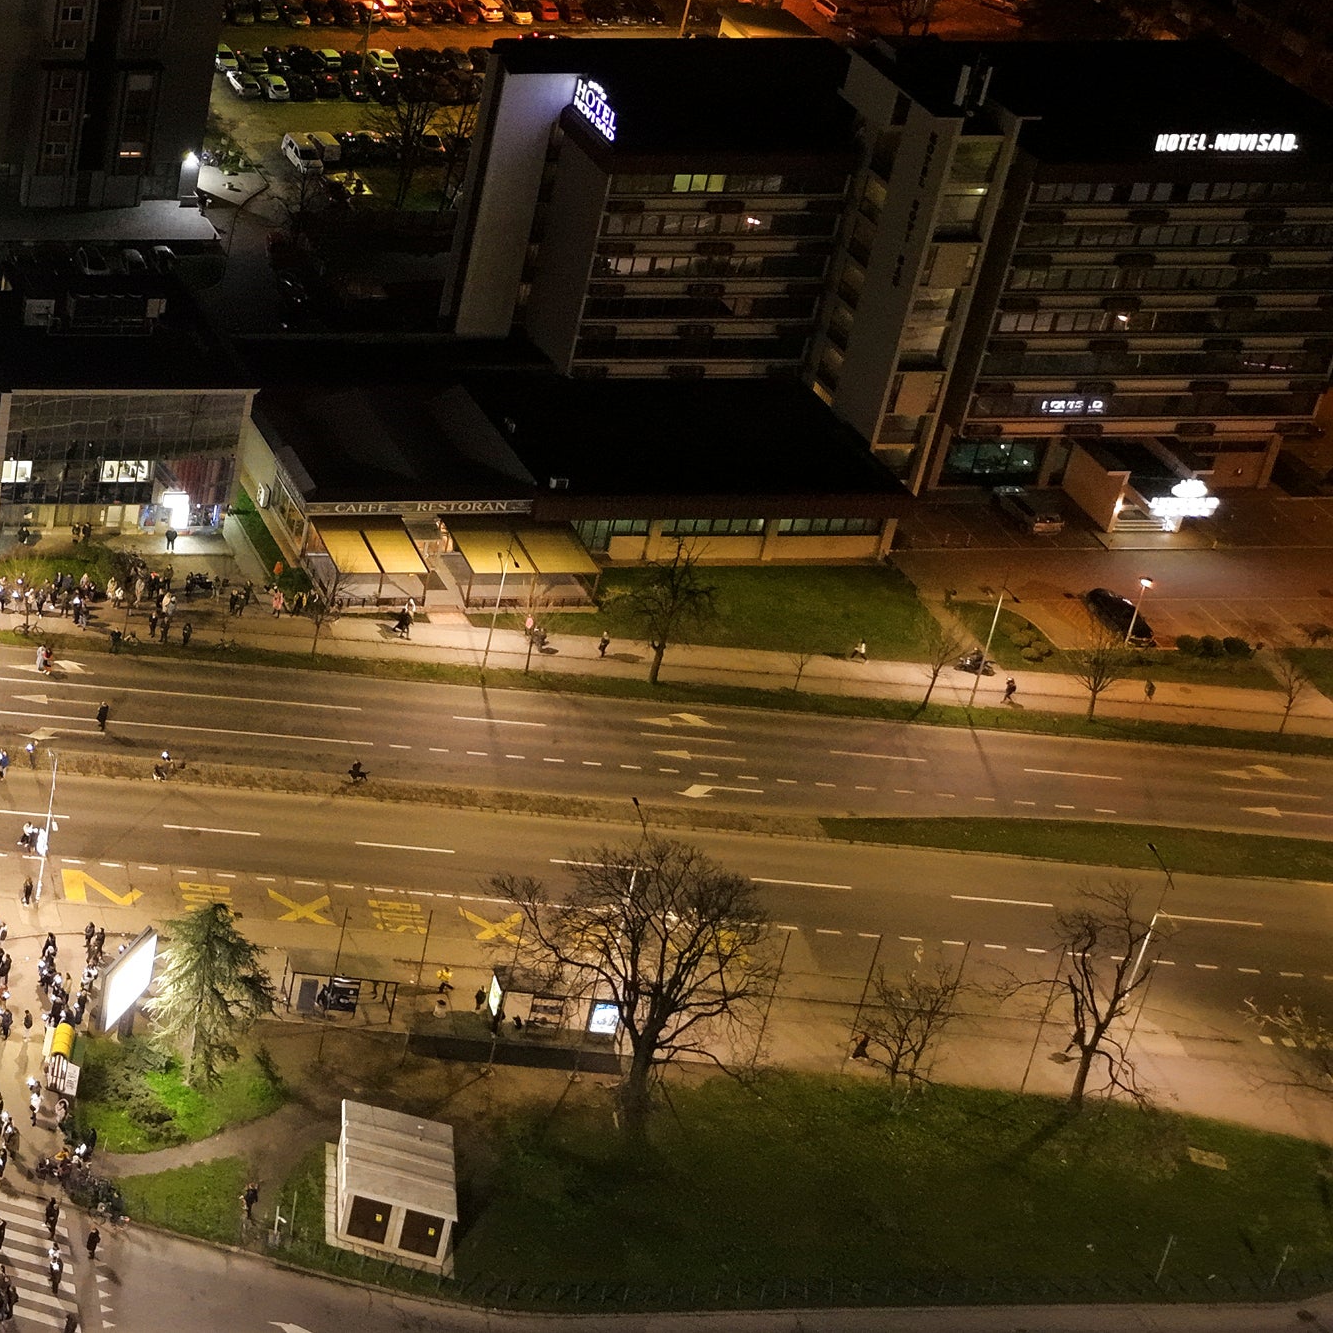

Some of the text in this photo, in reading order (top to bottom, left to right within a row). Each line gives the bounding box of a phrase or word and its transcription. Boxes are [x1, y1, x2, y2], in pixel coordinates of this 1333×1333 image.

[576, 79, 616, 131] HOTEL
[1155, 133, 1207, 152] HOTEL
[416, 501, 508, 512] RESTORAN
